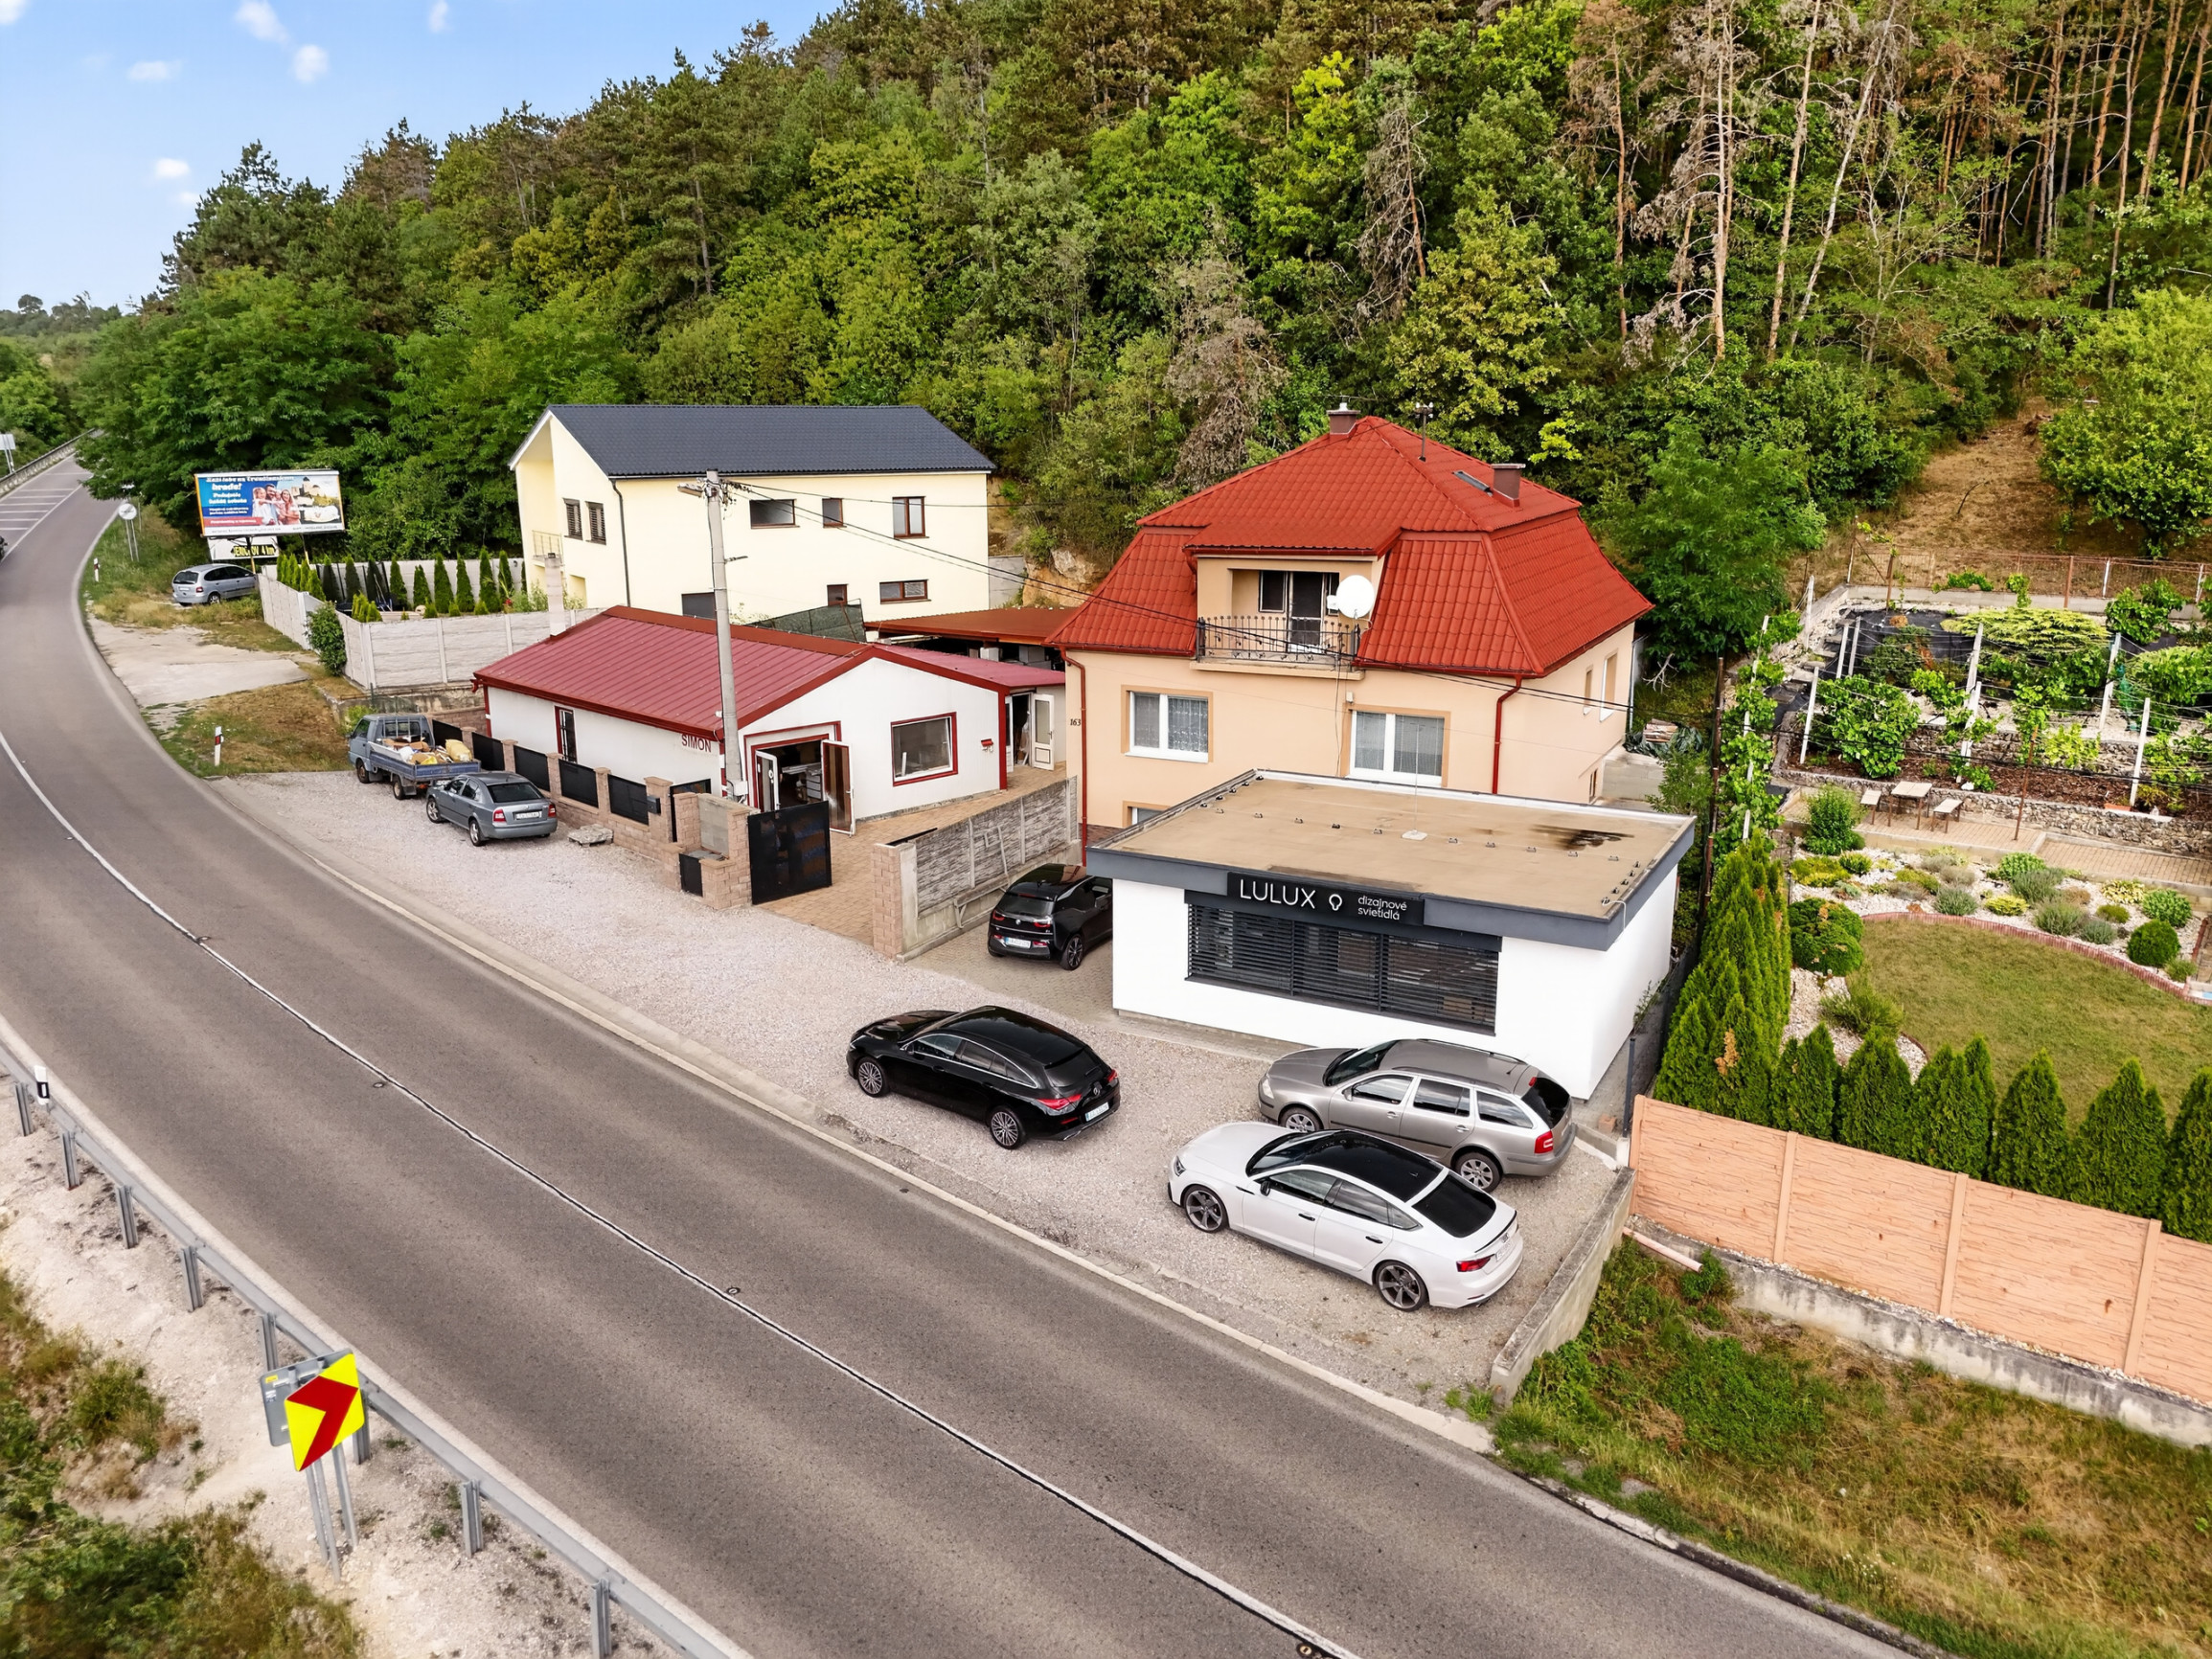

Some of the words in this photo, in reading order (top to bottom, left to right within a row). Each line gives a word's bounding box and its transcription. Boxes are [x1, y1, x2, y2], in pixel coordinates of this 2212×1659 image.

[681, 734, 712, 753] SIMON
[1240, 878, 1316, 909] LULUX
[1357, 895, 1407, 911] dizajnové
[1357, 906, 1401, 920] svietidlá
